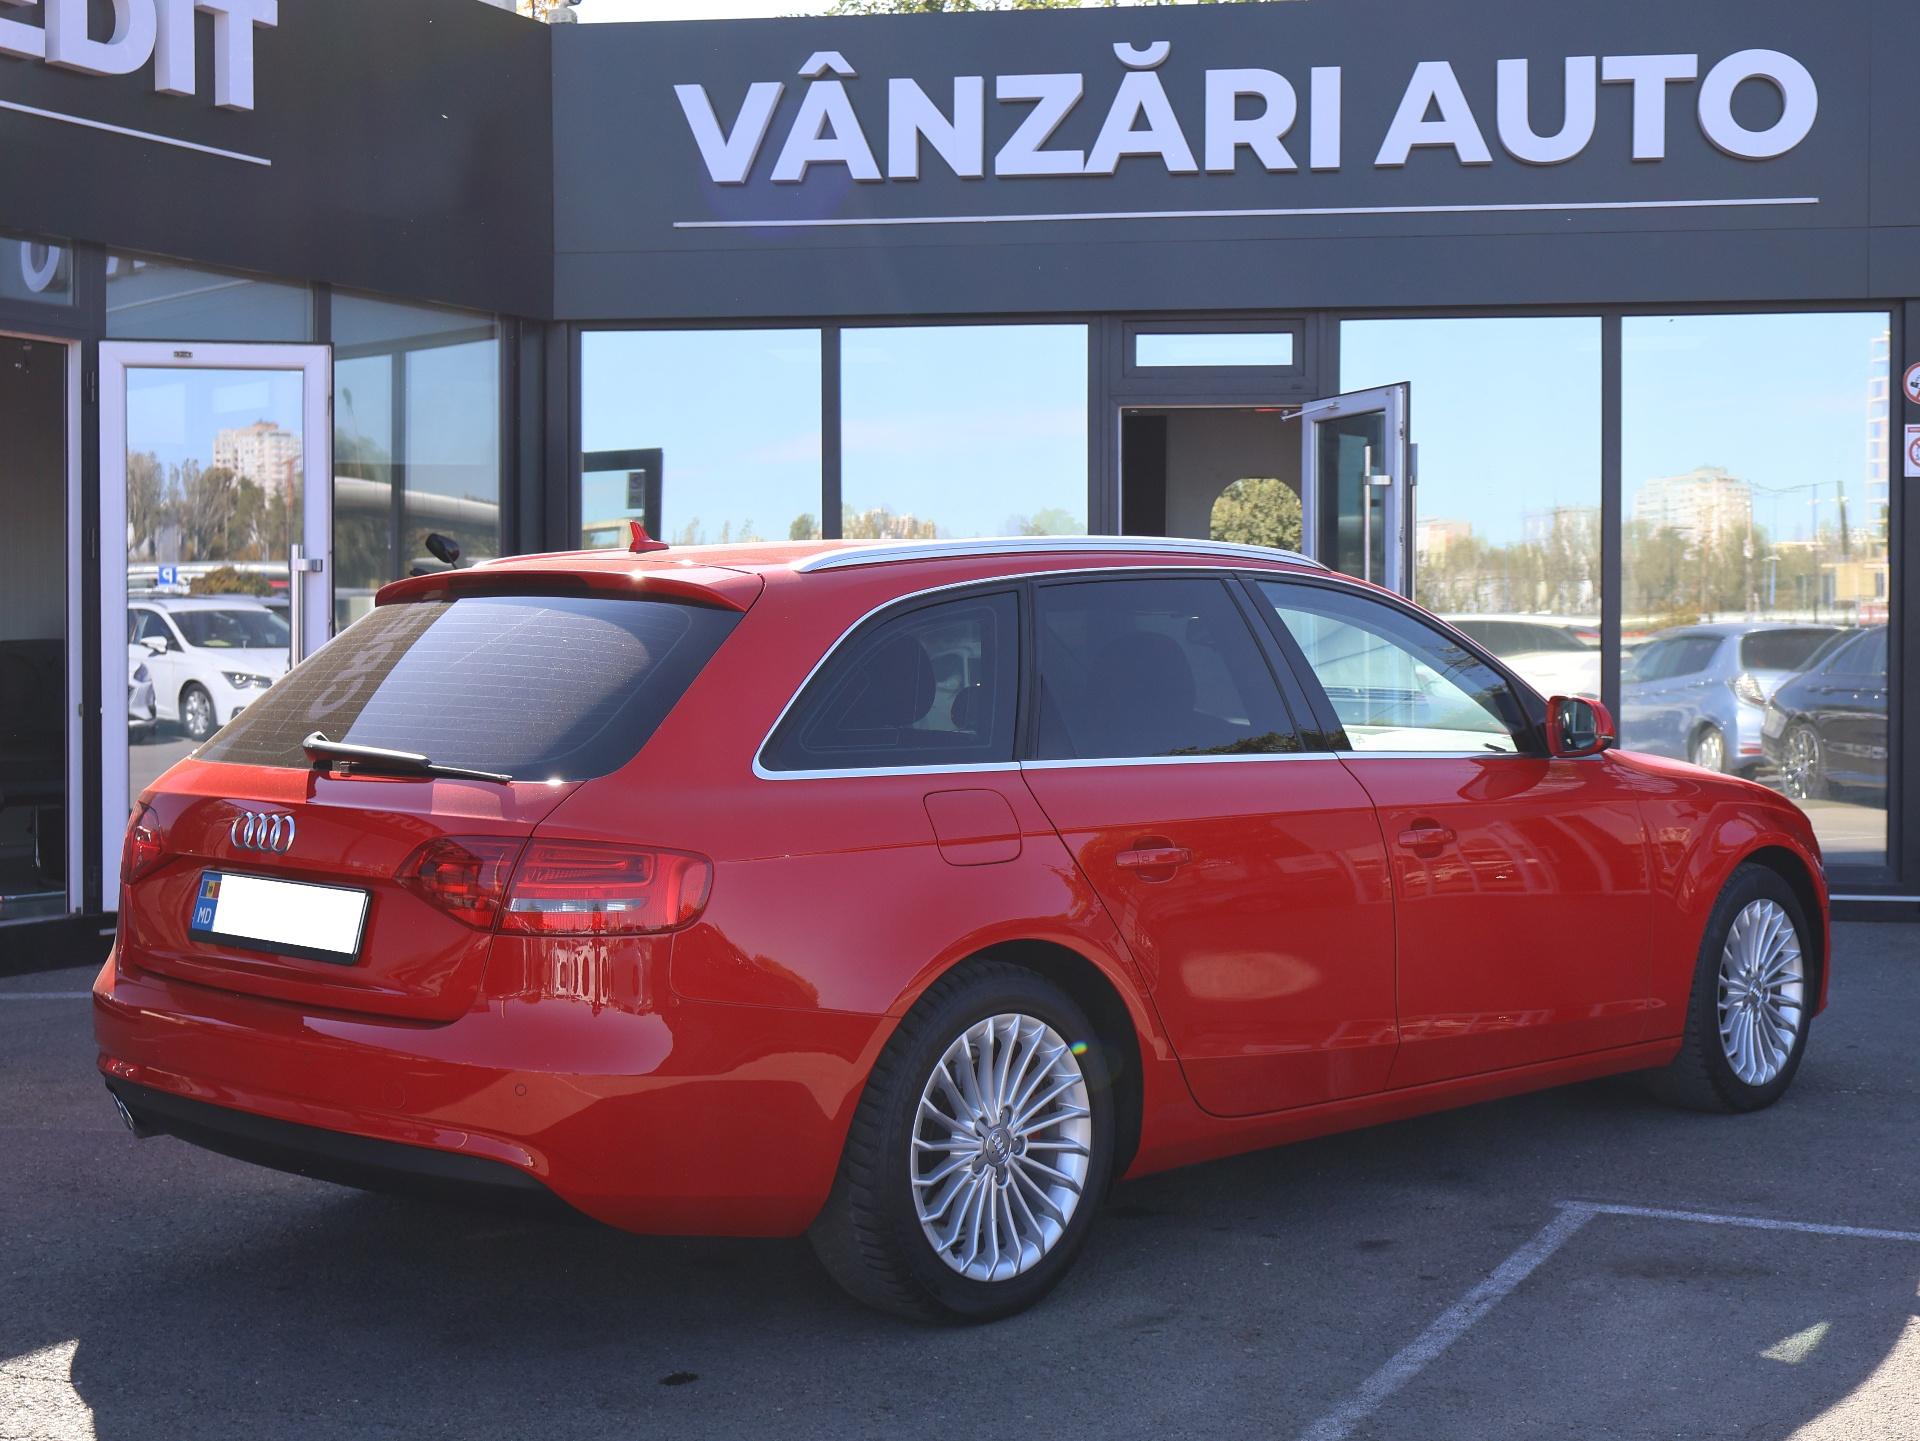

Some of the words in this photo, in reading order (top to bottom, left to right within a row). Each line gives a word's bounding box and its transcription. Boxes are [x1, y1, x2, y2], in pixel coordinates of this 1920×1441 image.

[673, 41, 1342, 184] VÂNZĂRI
[1374, 48, 1819, 168] AUTO
[197, 906, 212, 925] MD
